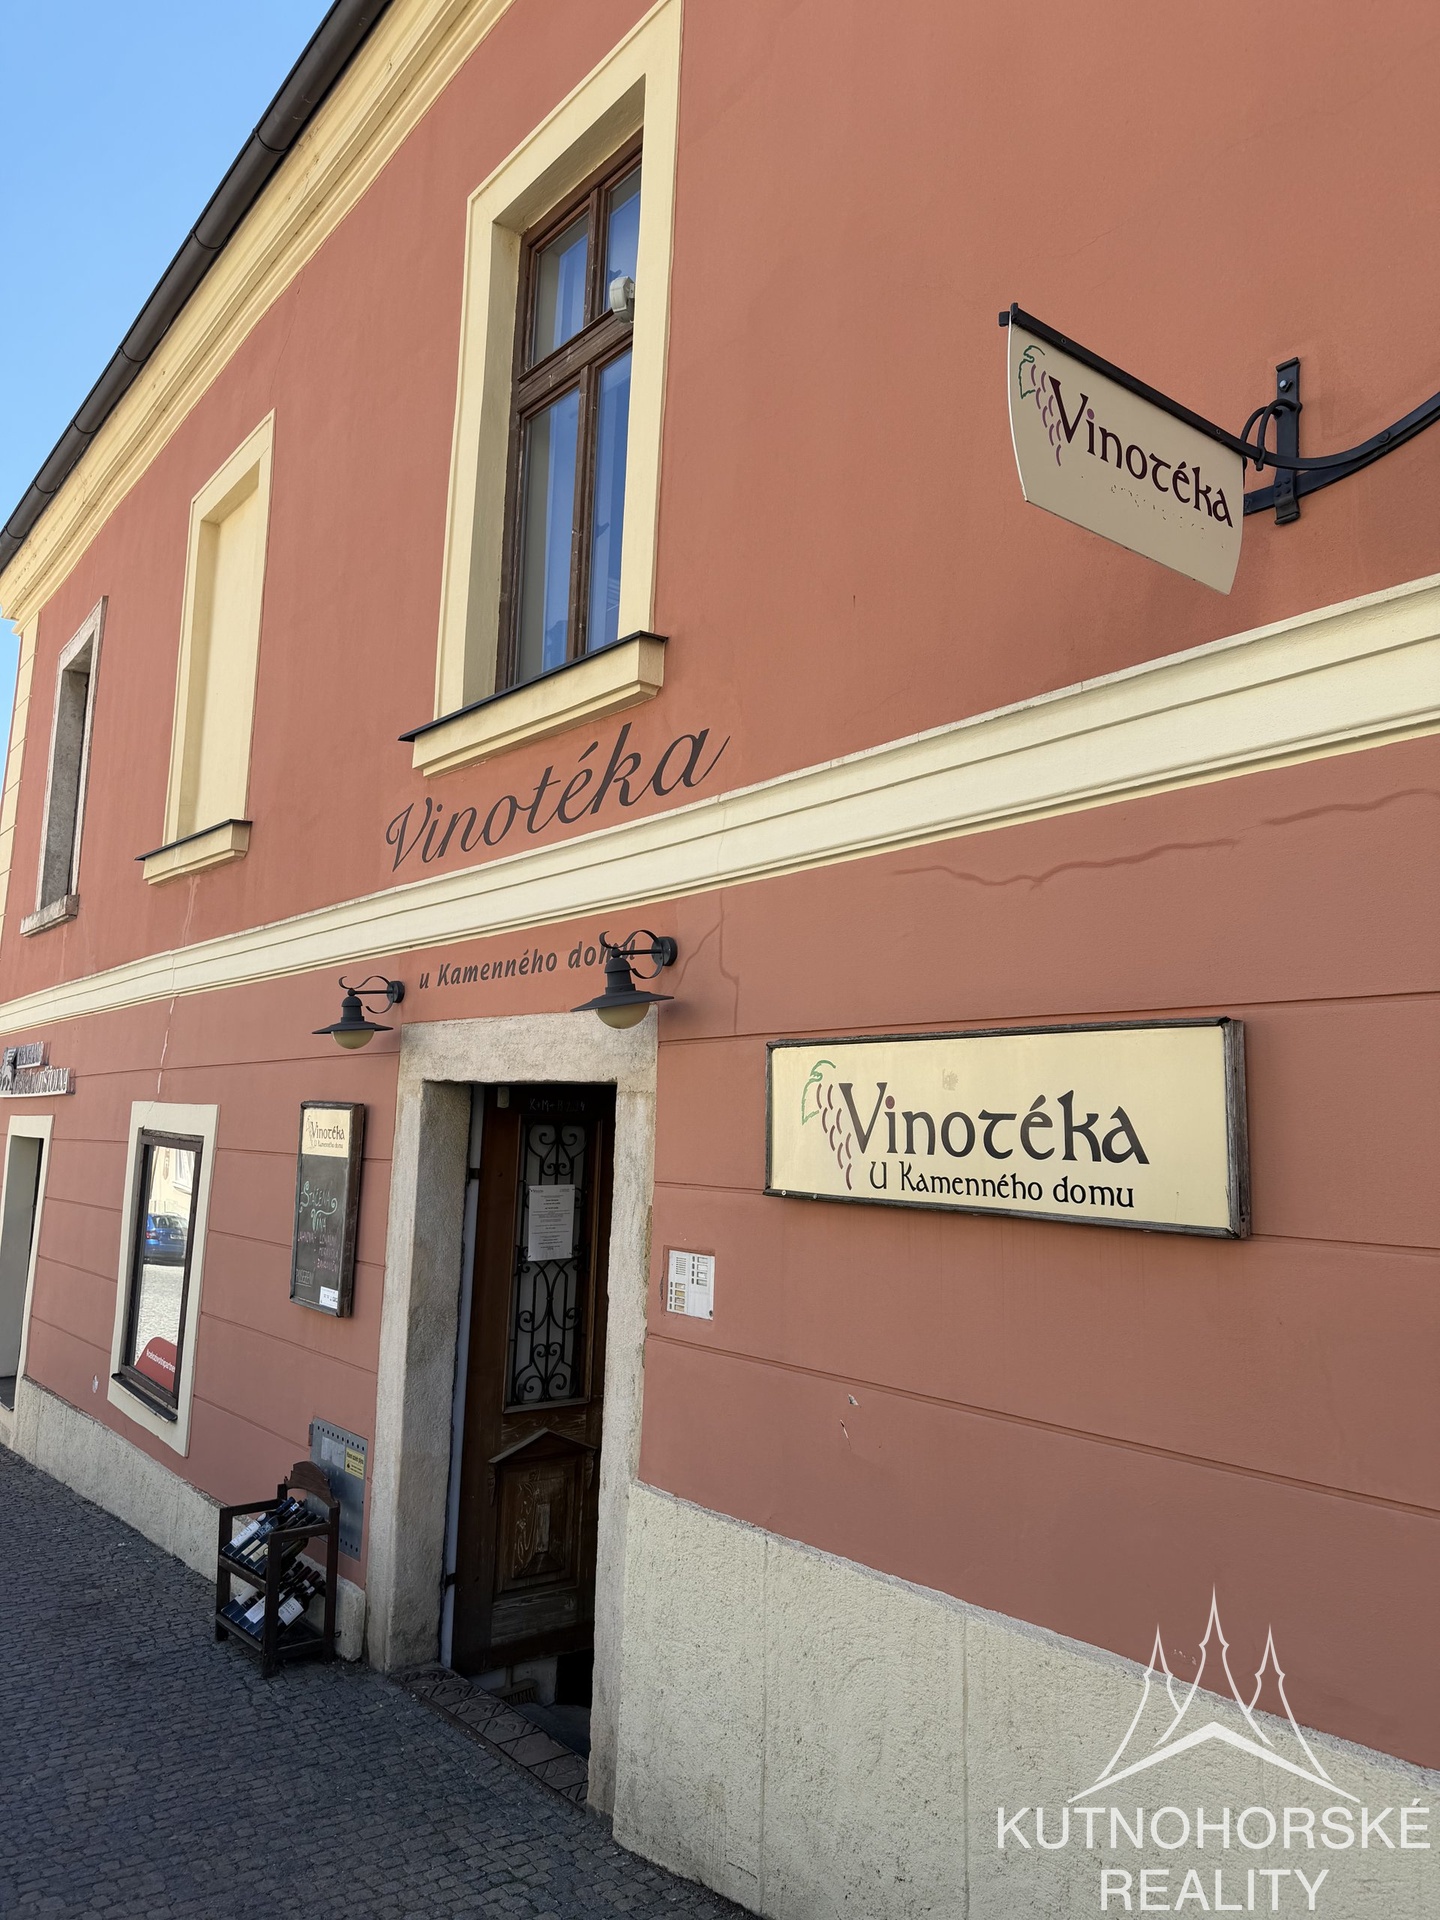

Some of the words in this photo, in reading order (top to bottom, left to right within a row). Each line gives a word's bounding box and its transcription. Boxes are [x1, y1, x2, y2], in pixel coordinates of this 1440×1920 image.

[1048, 375, 1234, 528] Vinotéka
[385, 722, 731, 873] Vinotéka
[418, 971, 430, 990] u
[436, 949, 558, 986] Kamenného
[310, 1121, 346, 1141] Vinotéka
[838, 1082, 1151, 1165] Vinotéka
[869, 1160, 888, 1190] U
[899, 1161, 1043, 1202] Kamenného
[1052, 1174, 1135, 1208] domu
